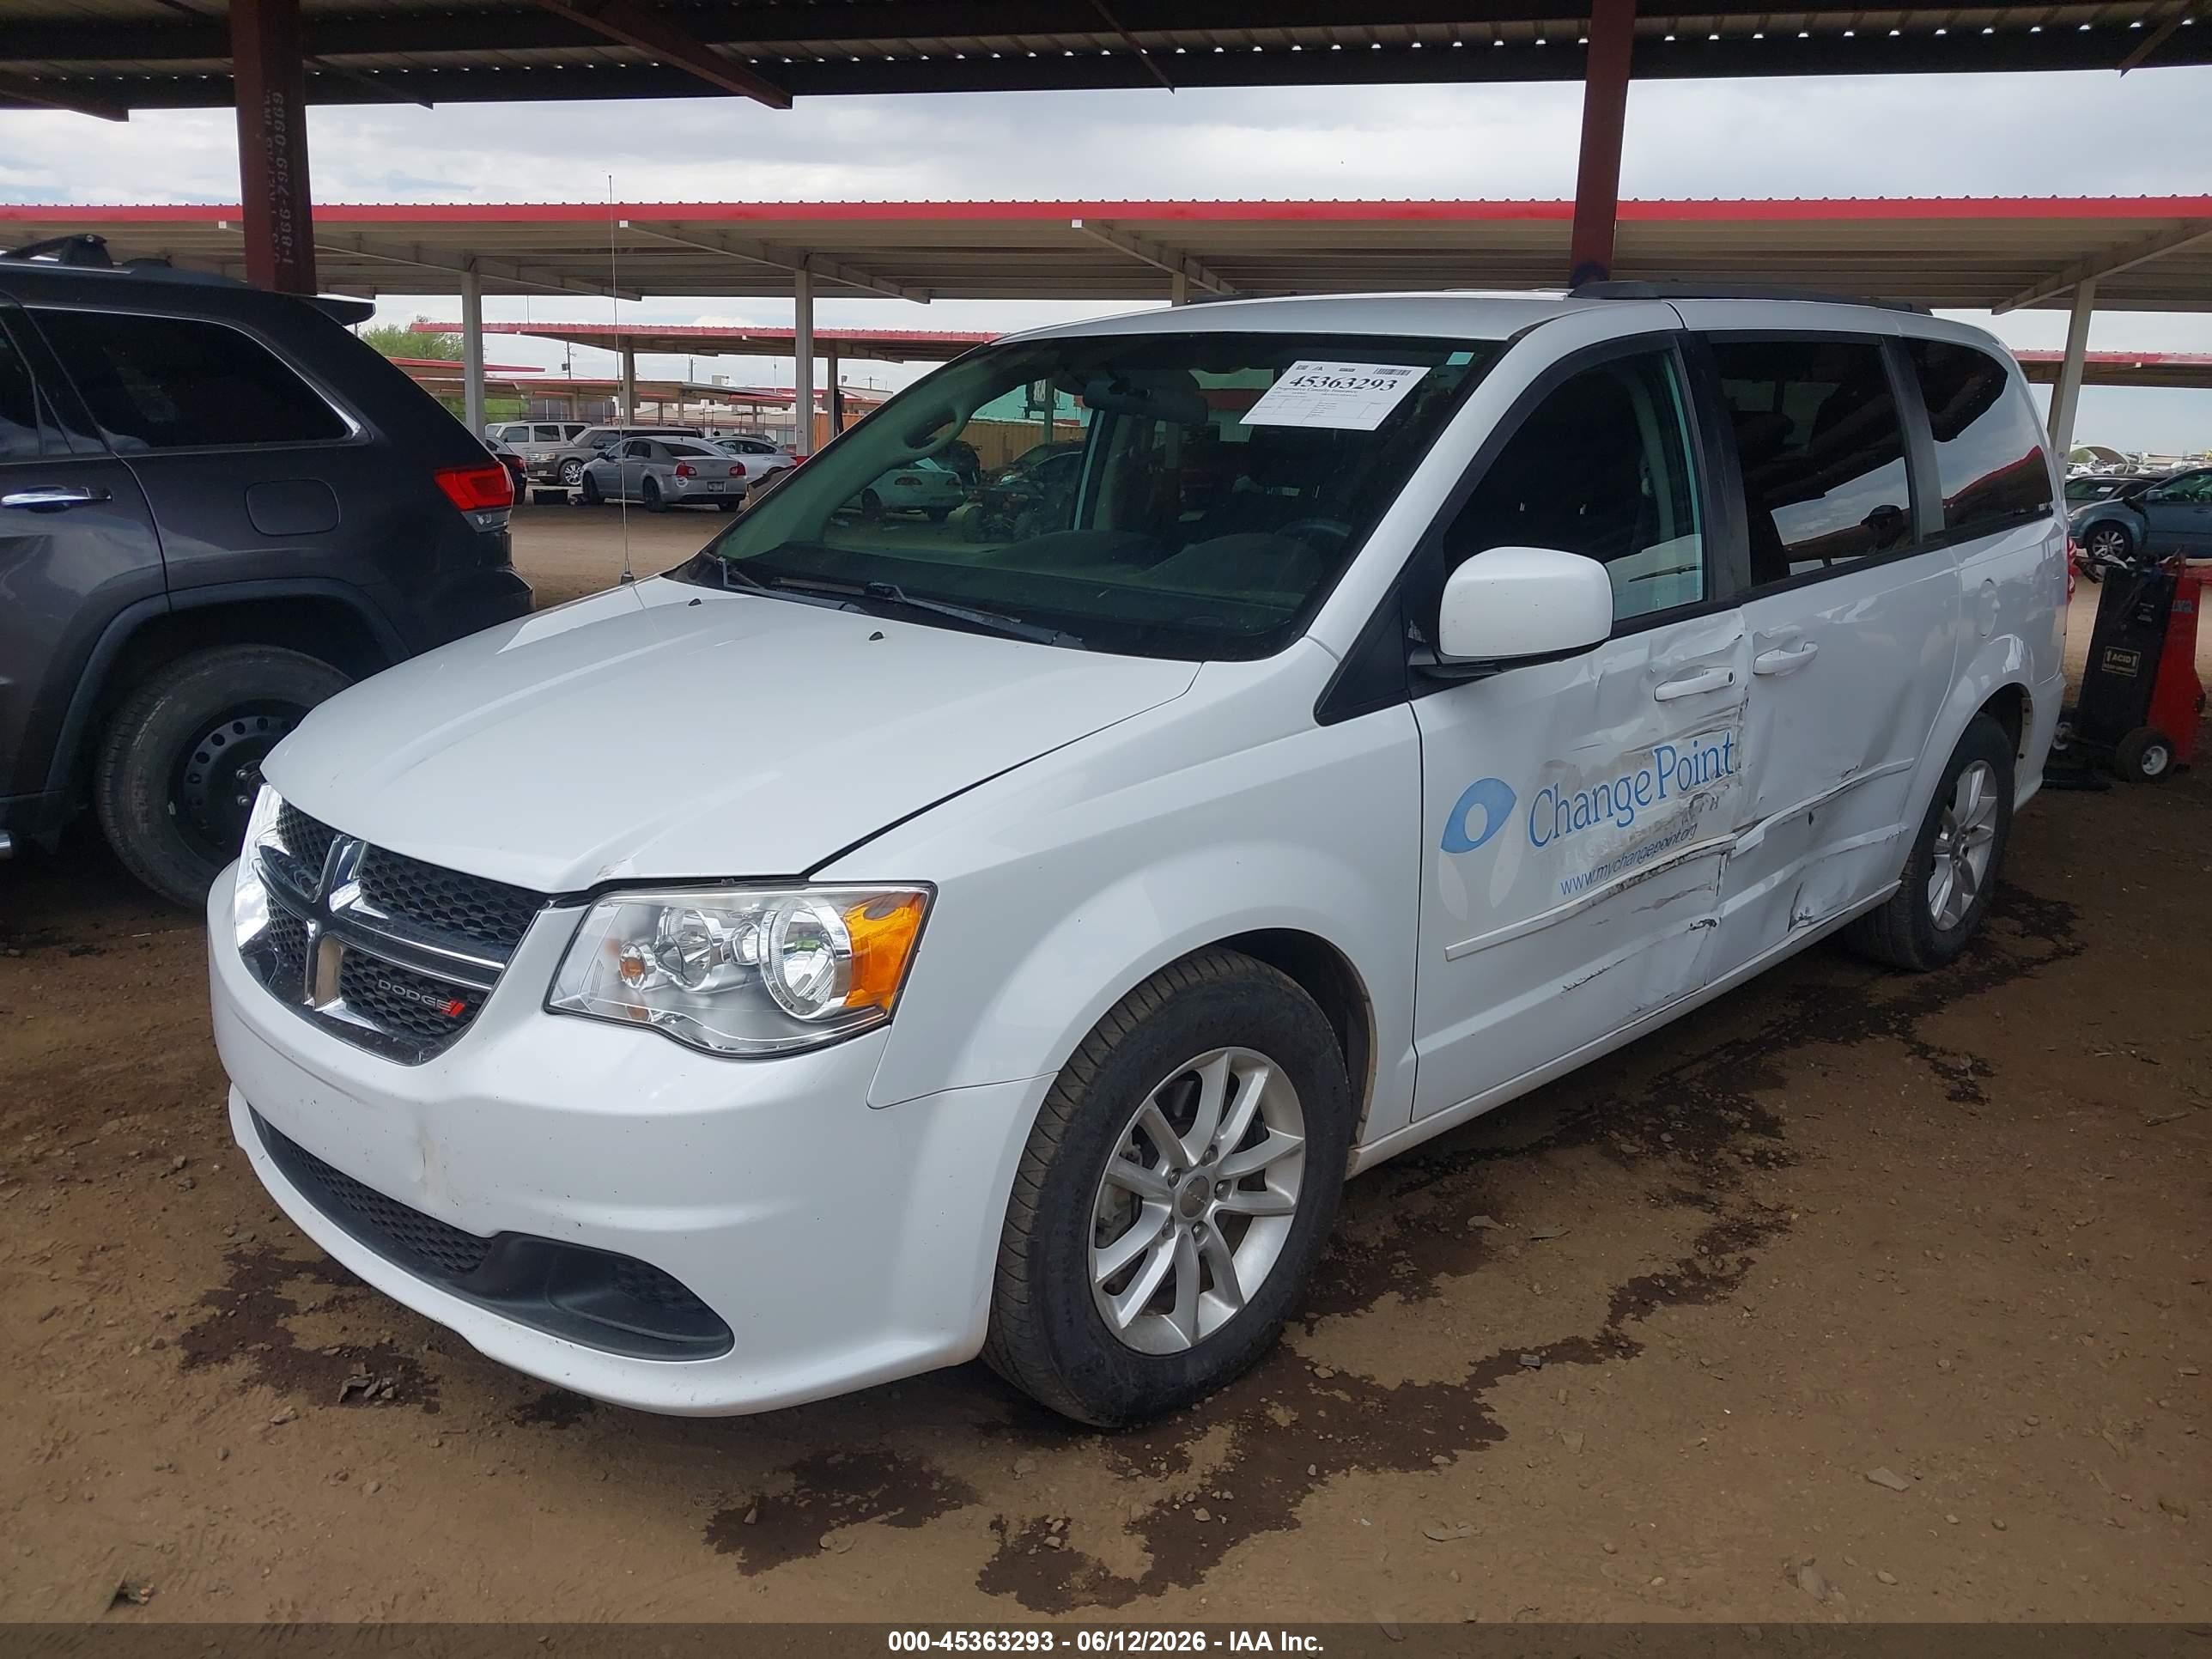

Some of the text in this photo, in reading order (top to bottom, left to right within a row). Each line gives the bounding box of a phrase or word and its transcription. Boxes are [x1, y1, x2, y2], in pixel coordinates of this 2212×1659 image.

[1289, 375, 1397, 392] 45363293
[2112, 653, 2131, 663] ACID
[1528, 732, 1735, 848] ChangePoint
[1559, 822, 1698, 896] www.mychangepoint.org
[378, 979, 451, 1012] DODGE
